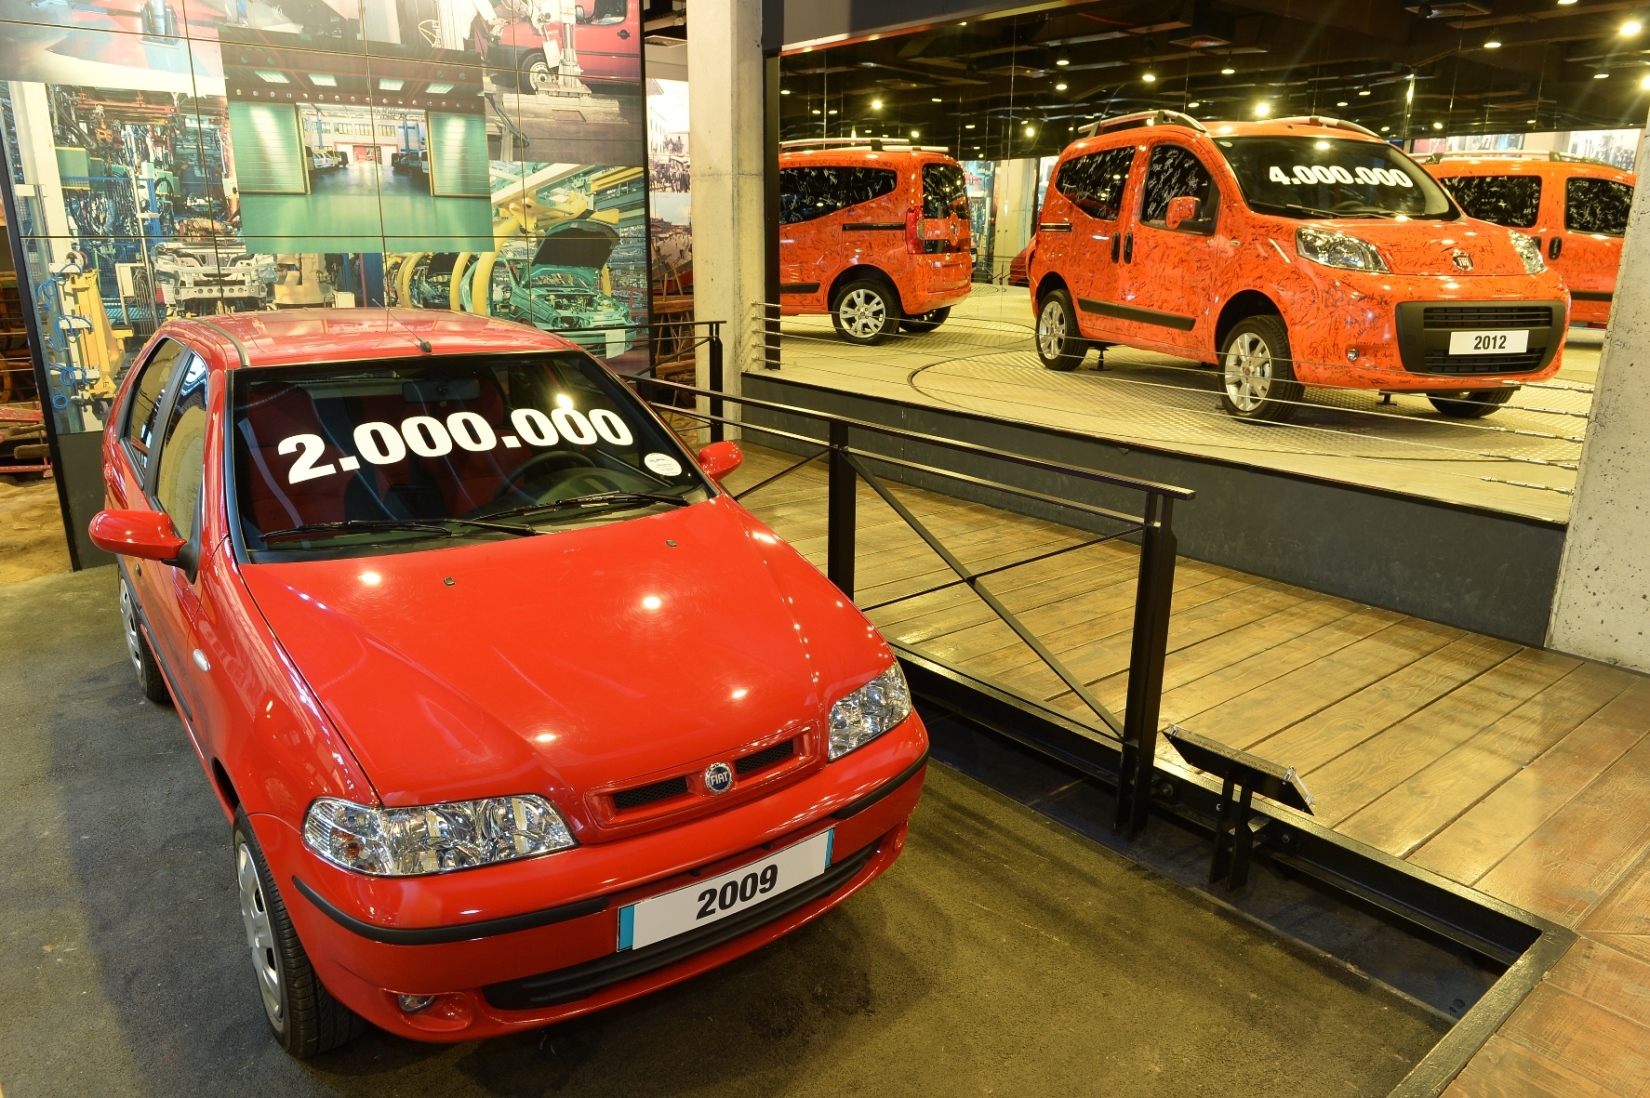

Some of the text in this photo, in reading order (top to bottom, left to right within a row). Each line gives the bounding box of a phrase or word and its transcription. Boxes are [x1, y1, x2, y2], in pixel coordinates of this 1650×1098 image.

[1269, 165, 1414, 188] 4.000.000
[1473, 334, 1507, 350] 2012
[277, 408, 634, 485] 2.000.000
[710, 771, 729, 786] FIAT
[696, 864, 778, 920] 2009
